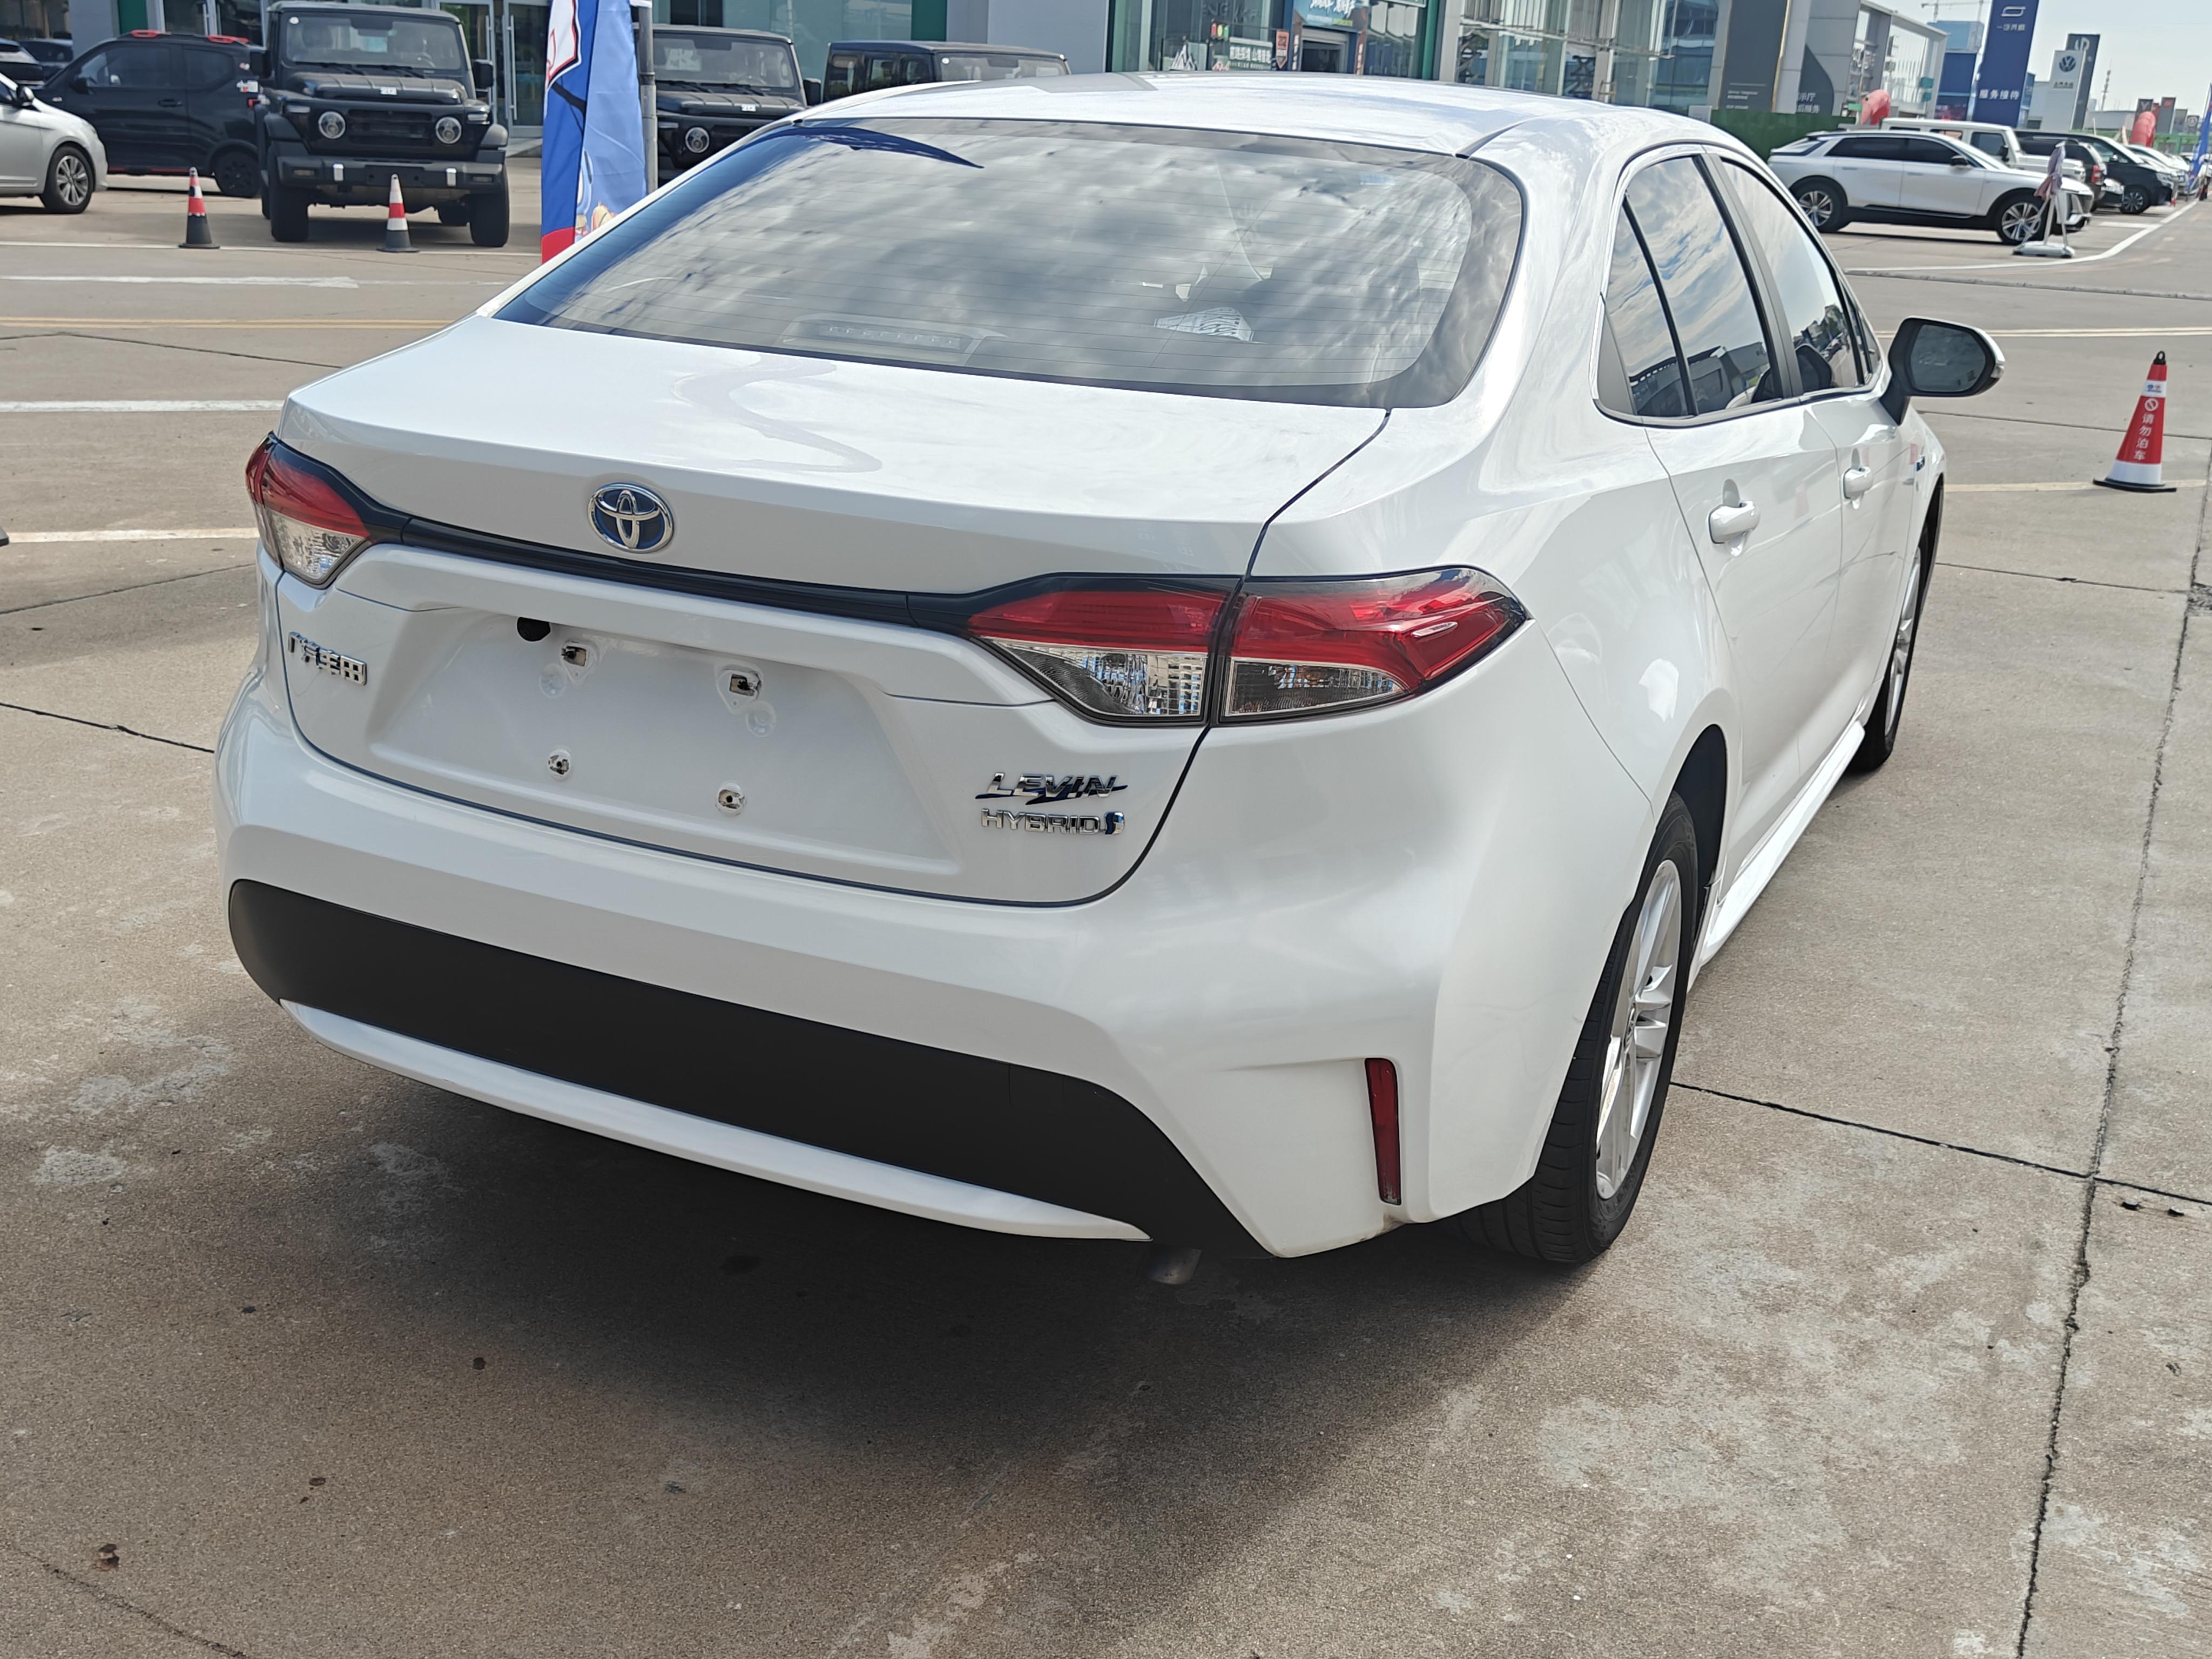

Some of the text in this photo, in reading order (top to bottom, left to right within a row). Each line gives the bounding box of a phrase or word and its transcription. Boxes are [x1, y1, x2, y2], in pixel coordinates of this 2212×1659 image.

[1979, 89, 2020, 100] 服务接待
[2134, 412, 2155, 461] 请勿泊车
[984, 772, 1120, 799] LEVIN
[980, 808, 1101, 835] HYBRID
